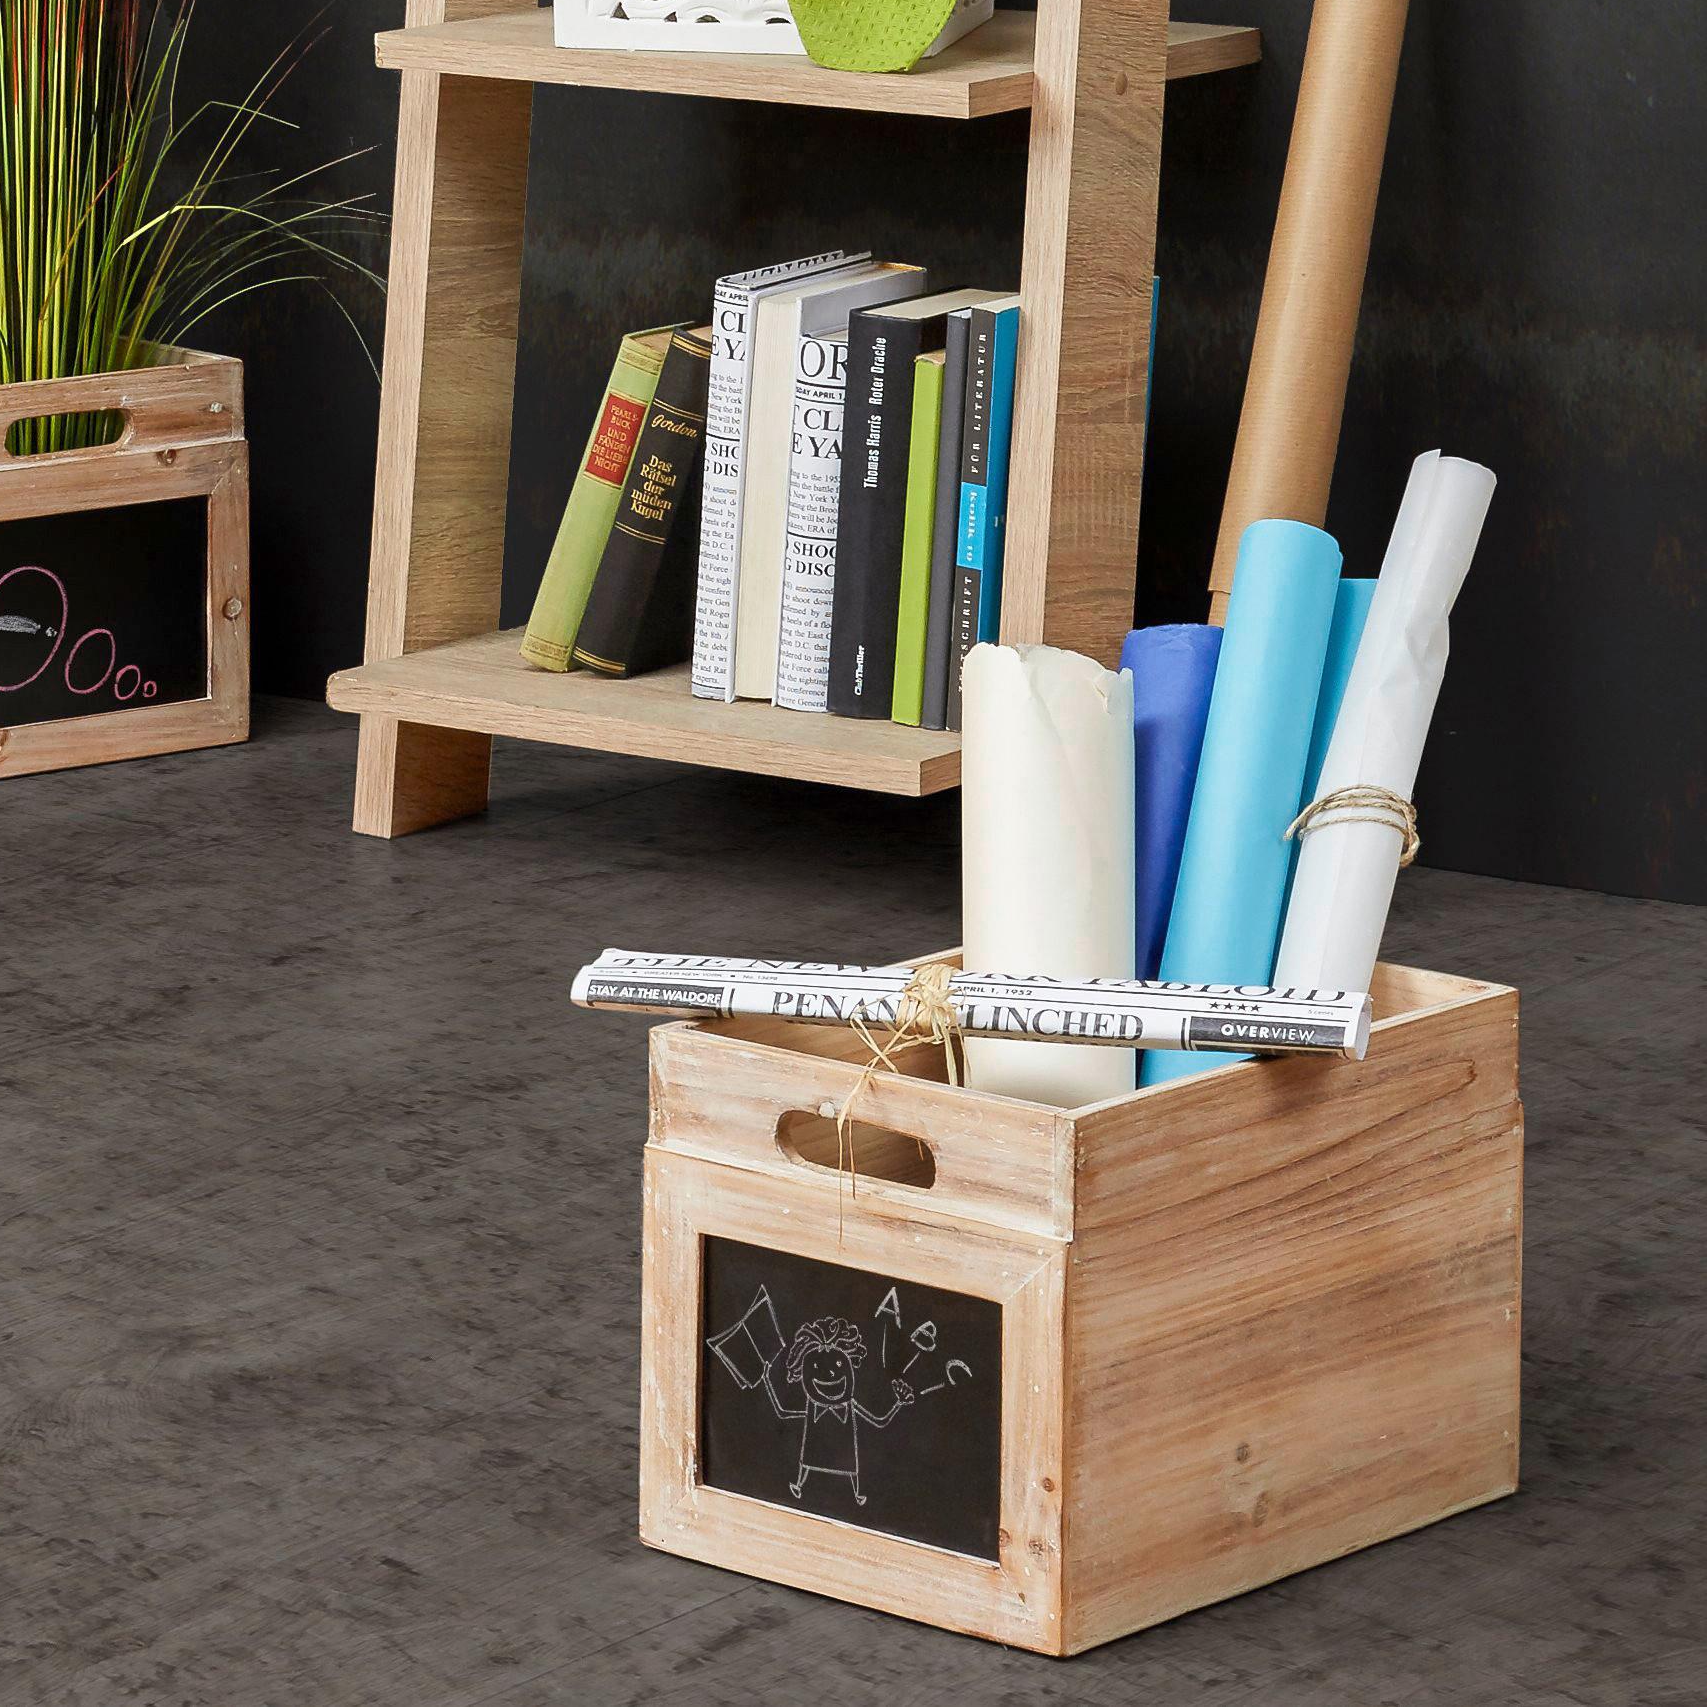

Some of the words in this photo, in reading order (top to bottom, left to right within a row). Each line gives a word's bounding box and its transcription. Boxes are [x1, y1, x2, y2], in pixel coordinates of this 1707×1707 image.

[870, 337, 887, 374] Drache
[868, 375, 884, 405] Roter
[972, 333, 988, 432] LITERATUR
[812, 390, 836, 400] APRIL
[607, 427, 627, 442] UND
[866, 414, 882, 447] Harris
[594, 455, 620, 473] NICHT
[649, 455, 673, 472] Das
[863, 449, 880, 489] Thomas
[640, 463, 677, 487] Rätsel
[643, 480, 666, 496] der
[809, 494, 827, 503] York
[630, 489, 672, 510] müden
[630, 499, 664, 522] Kugel
[807, 525, 825, 534] ERA
[588, 984, 618, 997] STAY
[619, 986, 636, 998] AT
[637, 987, 660, 1001] THE
[661, 988, 723, 1005] WALDORF
[1004, 988, 1033, 997] 1952
[955, 1001, 1144, 1042] LINCHED
[1220, 1022, 1316, 1042] OVERVIEW
[874, 1286, 903, 1330] A
